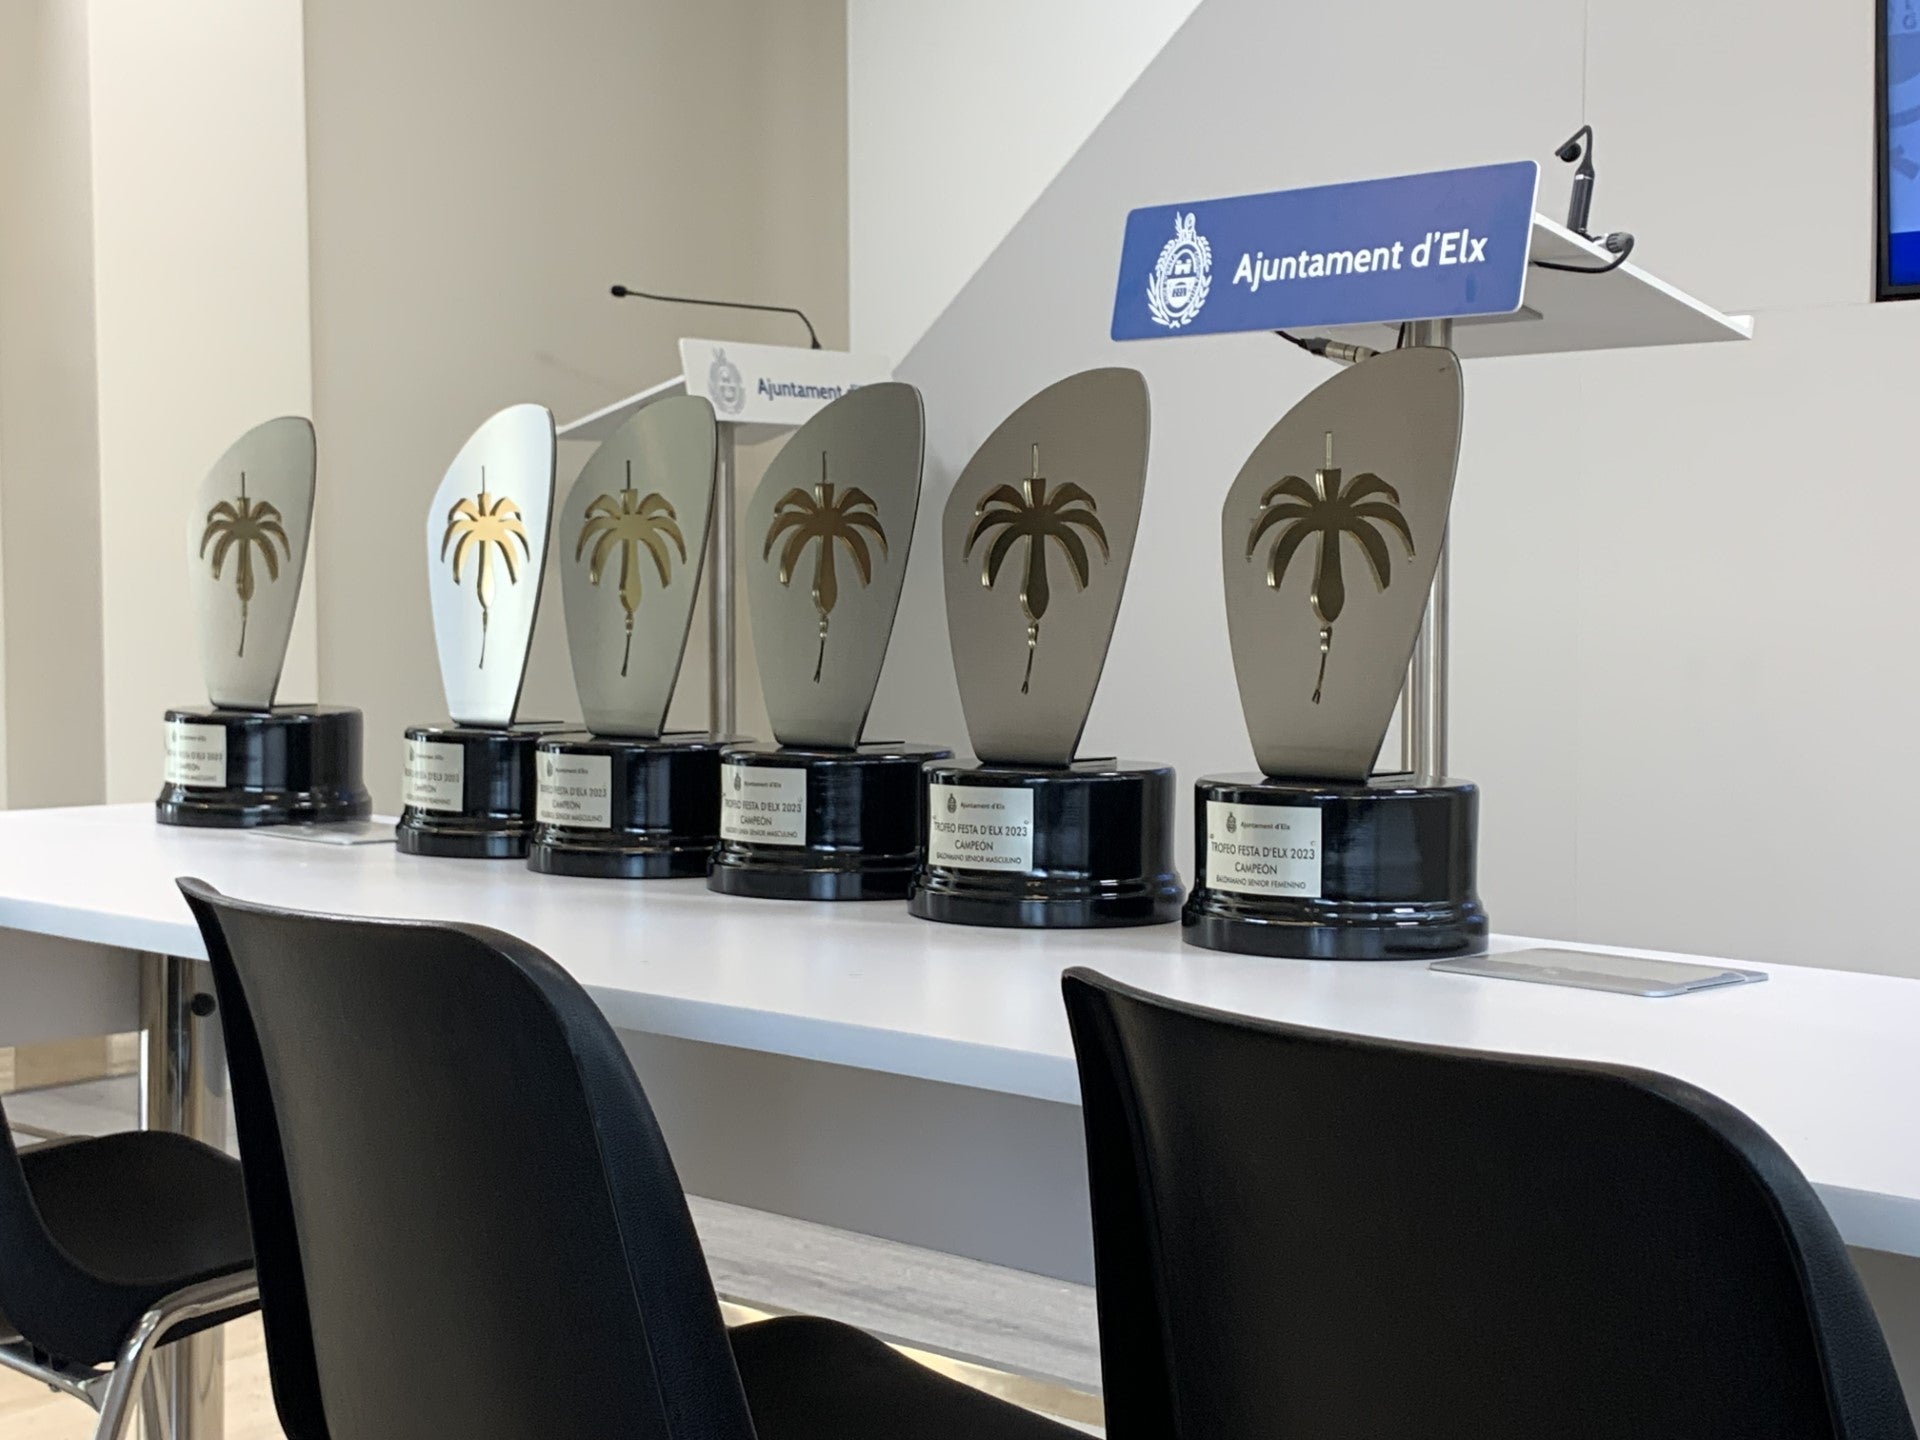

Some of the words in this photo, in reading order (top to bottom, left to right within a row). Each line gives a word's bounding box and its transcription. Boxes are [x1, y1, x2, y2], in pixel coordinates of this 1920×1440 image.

[1232, 241, 1404, 293] Ajuntament
[1411, 229, 1488, 268] d'Elx
[758, 378, 842, 400] Ajuntament
[589, 787, 607, 798] 2023
[761, 802, 781, 812] D'ELX
[782, 803, 802, 813] 2023
[934, 821, 957, 833] TROFEO
[958, 824, 979, 835] FESTA
[980, 825, 1004, 836] D'ELX
[1005, 826, 1028, 837] 2023
[1211, 841, 1236, 855] TROFEO
[1238, 844, 1260, 857] FESTA
[1262, 846, 1288, 859] D'ELX
[1291, 848, 1316, 860] 2023
[1248, 878, 1270, 888] SENIOR
[1271, 880, 1306, 889] FEMENINO
